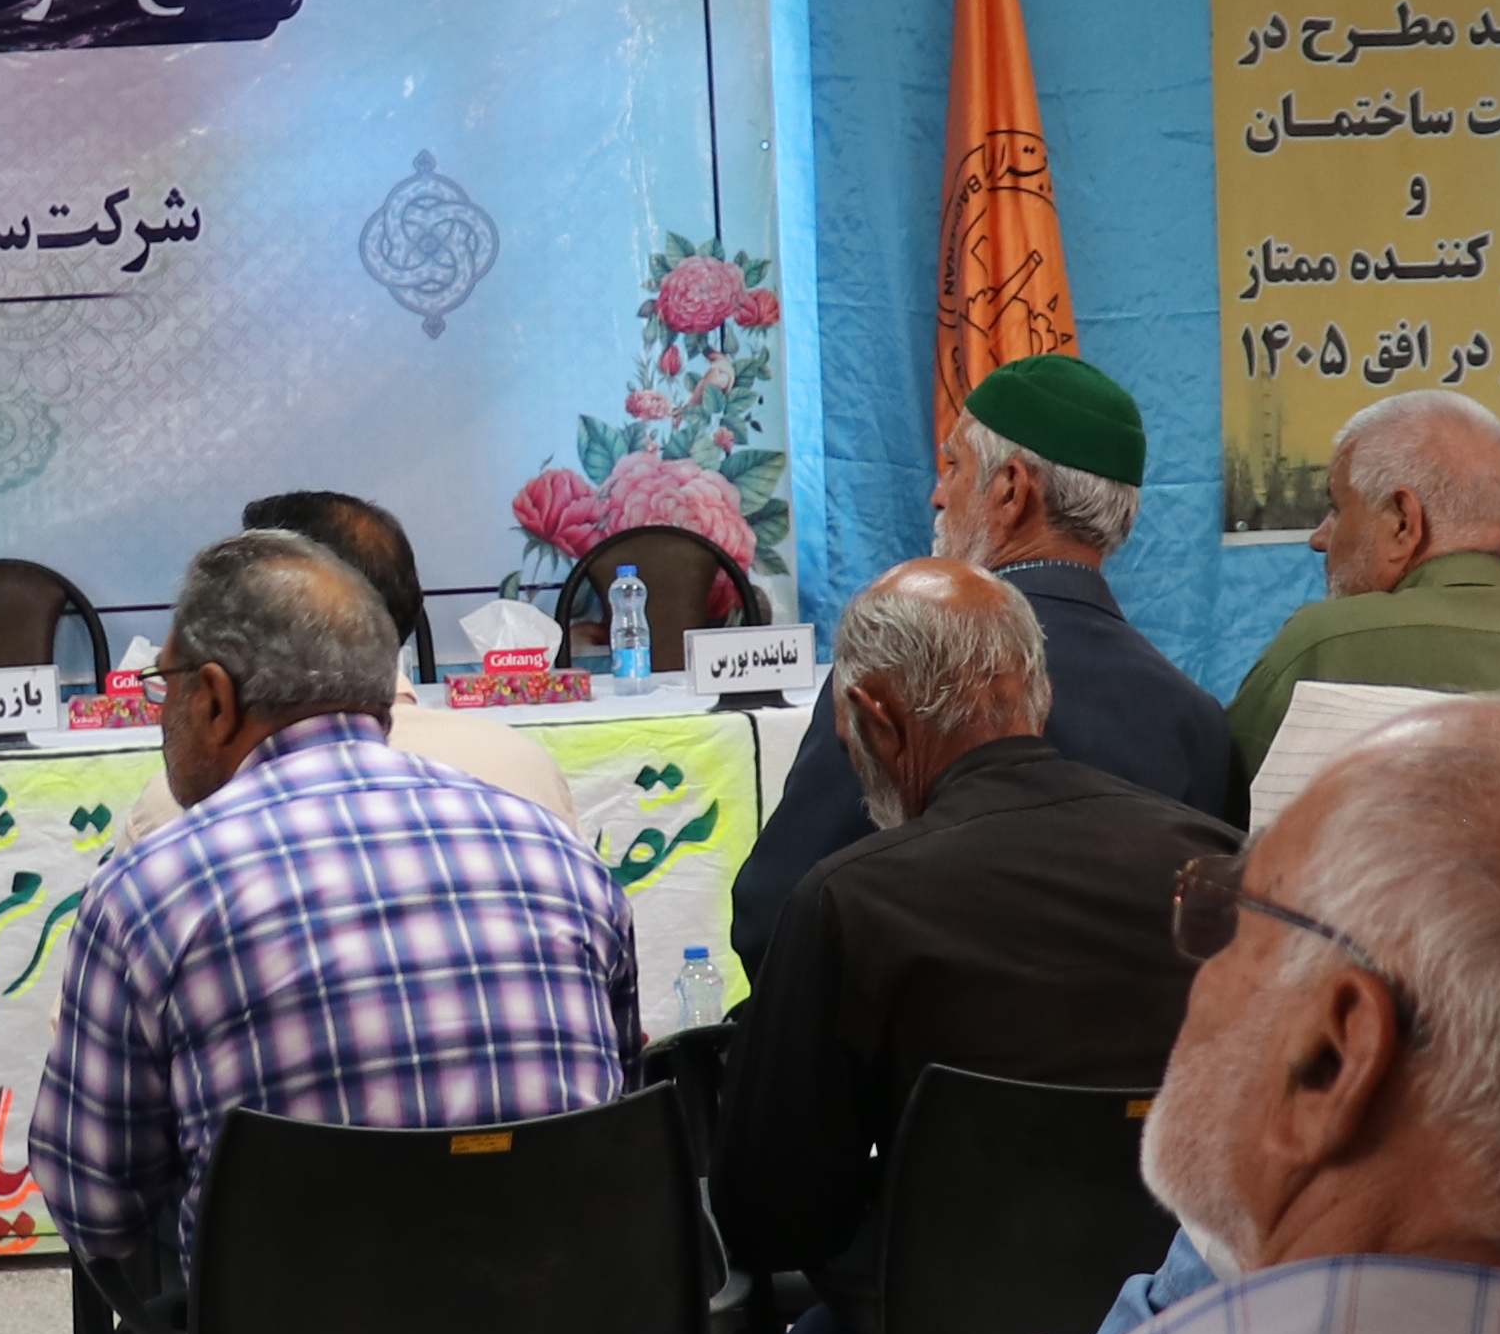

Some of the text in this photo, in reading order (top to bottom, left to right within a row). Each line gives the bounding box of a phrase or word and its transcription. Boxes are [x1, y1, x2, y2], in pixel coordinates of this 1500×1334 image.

[1238, 13, 1289, 65] در
[1300, 0, 1456, 64] مطرح
[1245, 89, 1455, 154] ساختمان
[1404, 173, 1429, 216] و
[36, 187, 202, 273] شرکت
[1349, 232, 1491, 281] کننده
[1238, 237, 1339, 300] ممتاز
[1241, 320, 1350, 378] ۱۴۰۵
[1362, 320, 1430, 386] افق
[1441, 331, 1491, 385] در
[489, 653, 545, 668] Golrang
[709, 639, 799, 682] نماینده بورس
